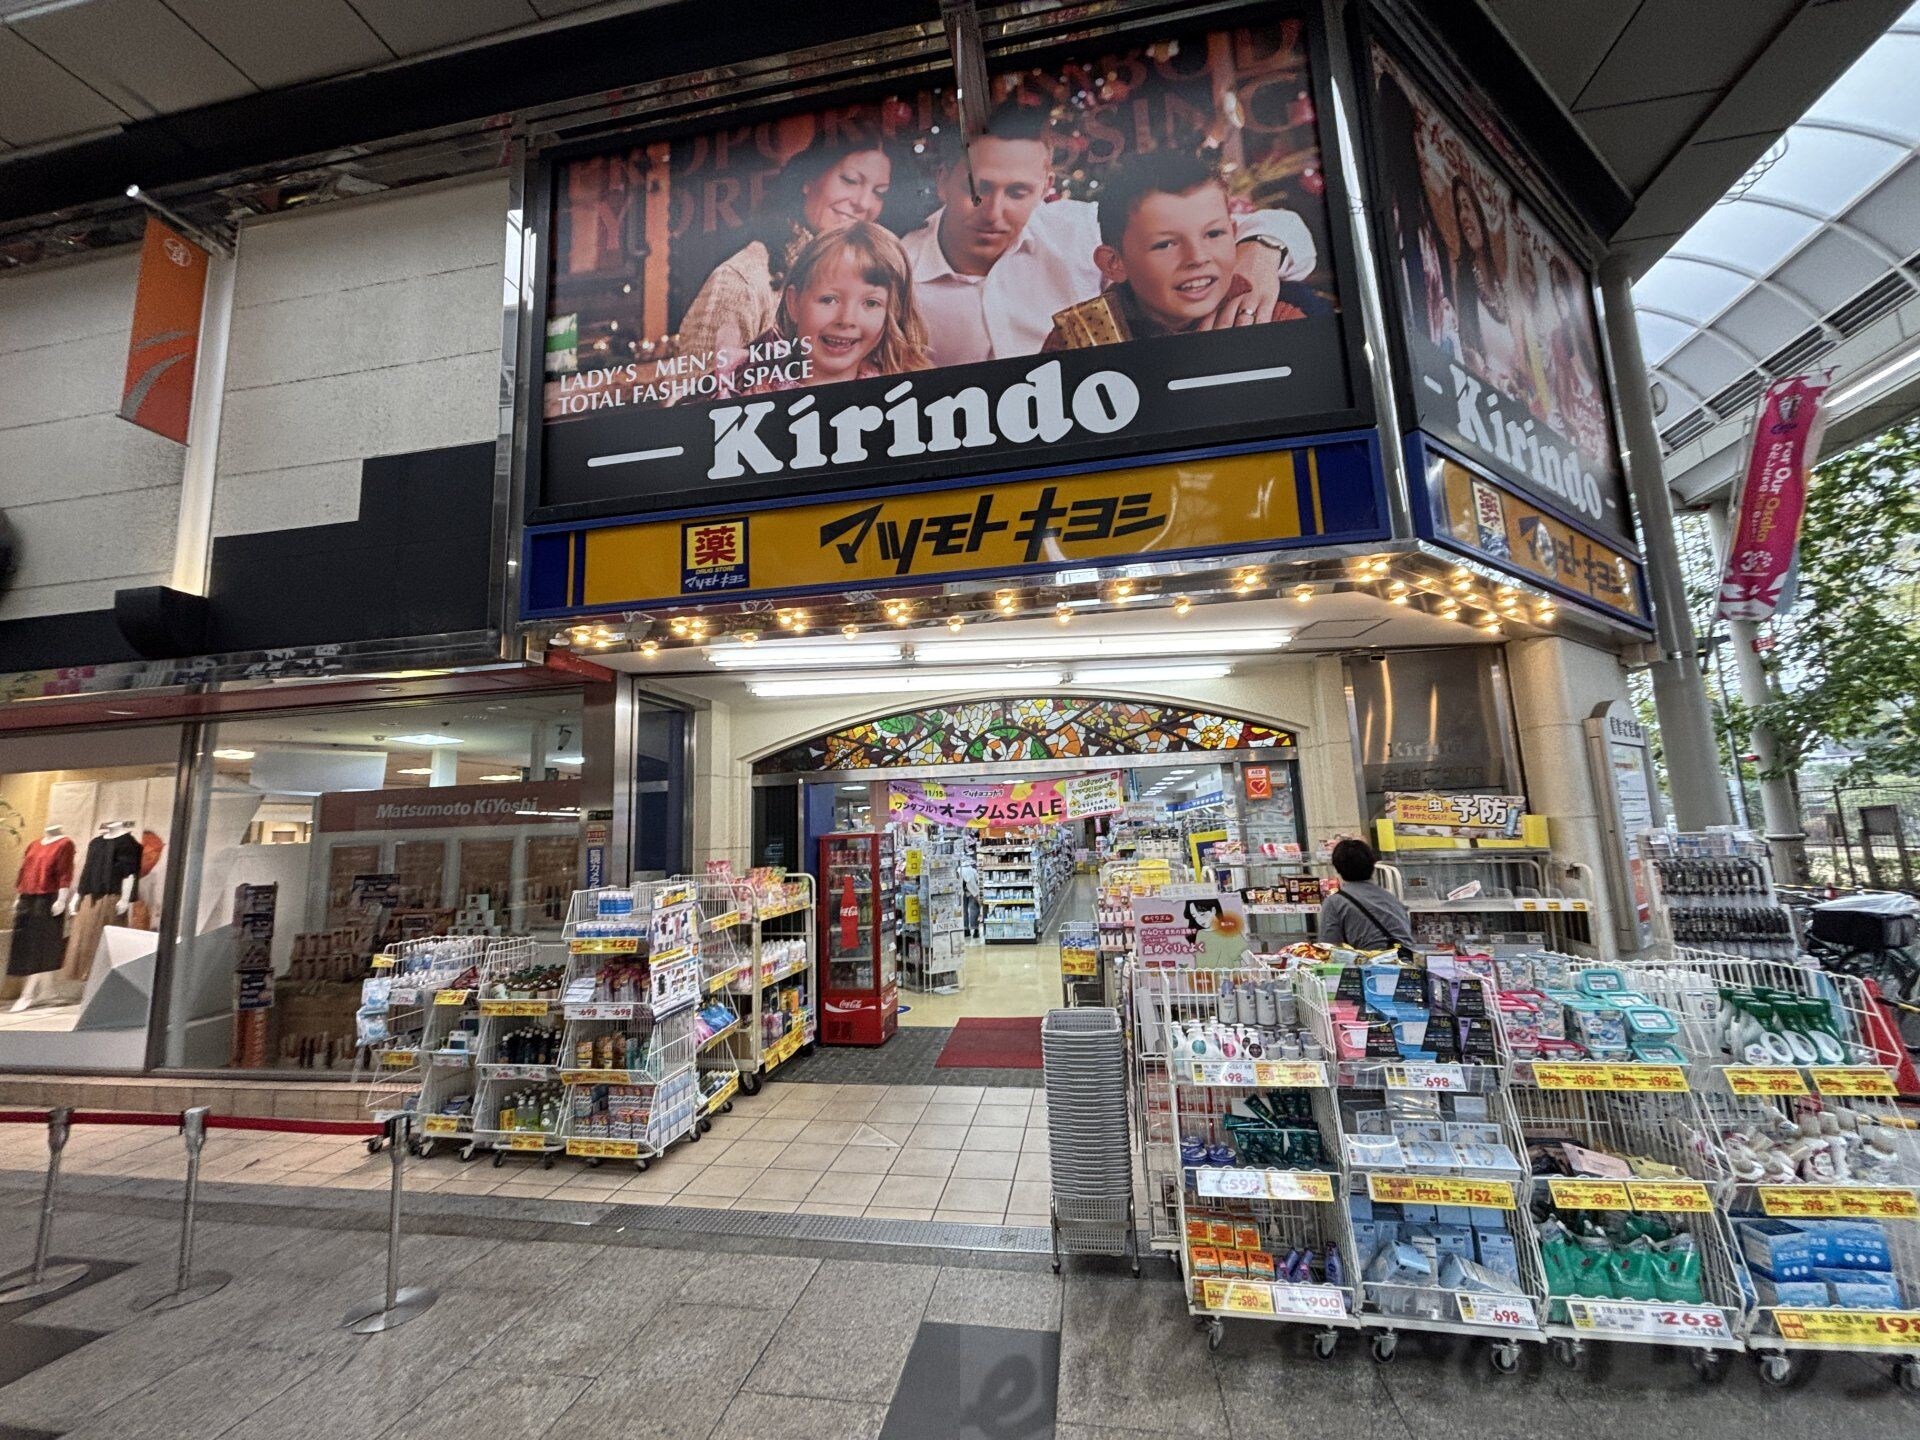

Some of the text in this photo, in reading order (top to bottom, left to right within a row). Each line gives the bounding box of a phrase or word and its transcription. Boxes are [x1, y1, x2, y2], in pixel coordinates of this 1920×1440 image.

[560, 335, 813, 392] LADY'S MEN'S KID'S
[558, 360, 814, 416] TOTAL FASHION SPACE
[706, 359, 1140, 481] Kirindo
[1450, 364, 1602, 520] Kirindo
[1770, 466, 1792, 495] Our
[1477, 487, 1500, 527] 薬
[820, 487, 1166, 575] マツモトキヨシ
[1756, 497, 1781, 543] Osaka
[694, 525, 736, 566] 薬
[685, 573, 746, 590] マツモトキヨシ
[695, 565, 735, 575] DRUG STORE
[924, 790, 944, 798] 11/15
[376, 797, 540, 819] Matsumoto KiYoshi
[1452, 797, 1508, 824] 予防
[1144, 942, 1205, 955] 血めぐりをよく
[1426, 1077, 1450, 1088] 698
[1465, 1189, 1492, 1203] 752
[1309, 1296, 1341, 1308] 900
[1495, 1311, 1520, 1323] 698
[1660, 1312, 1723, 1328] 268
